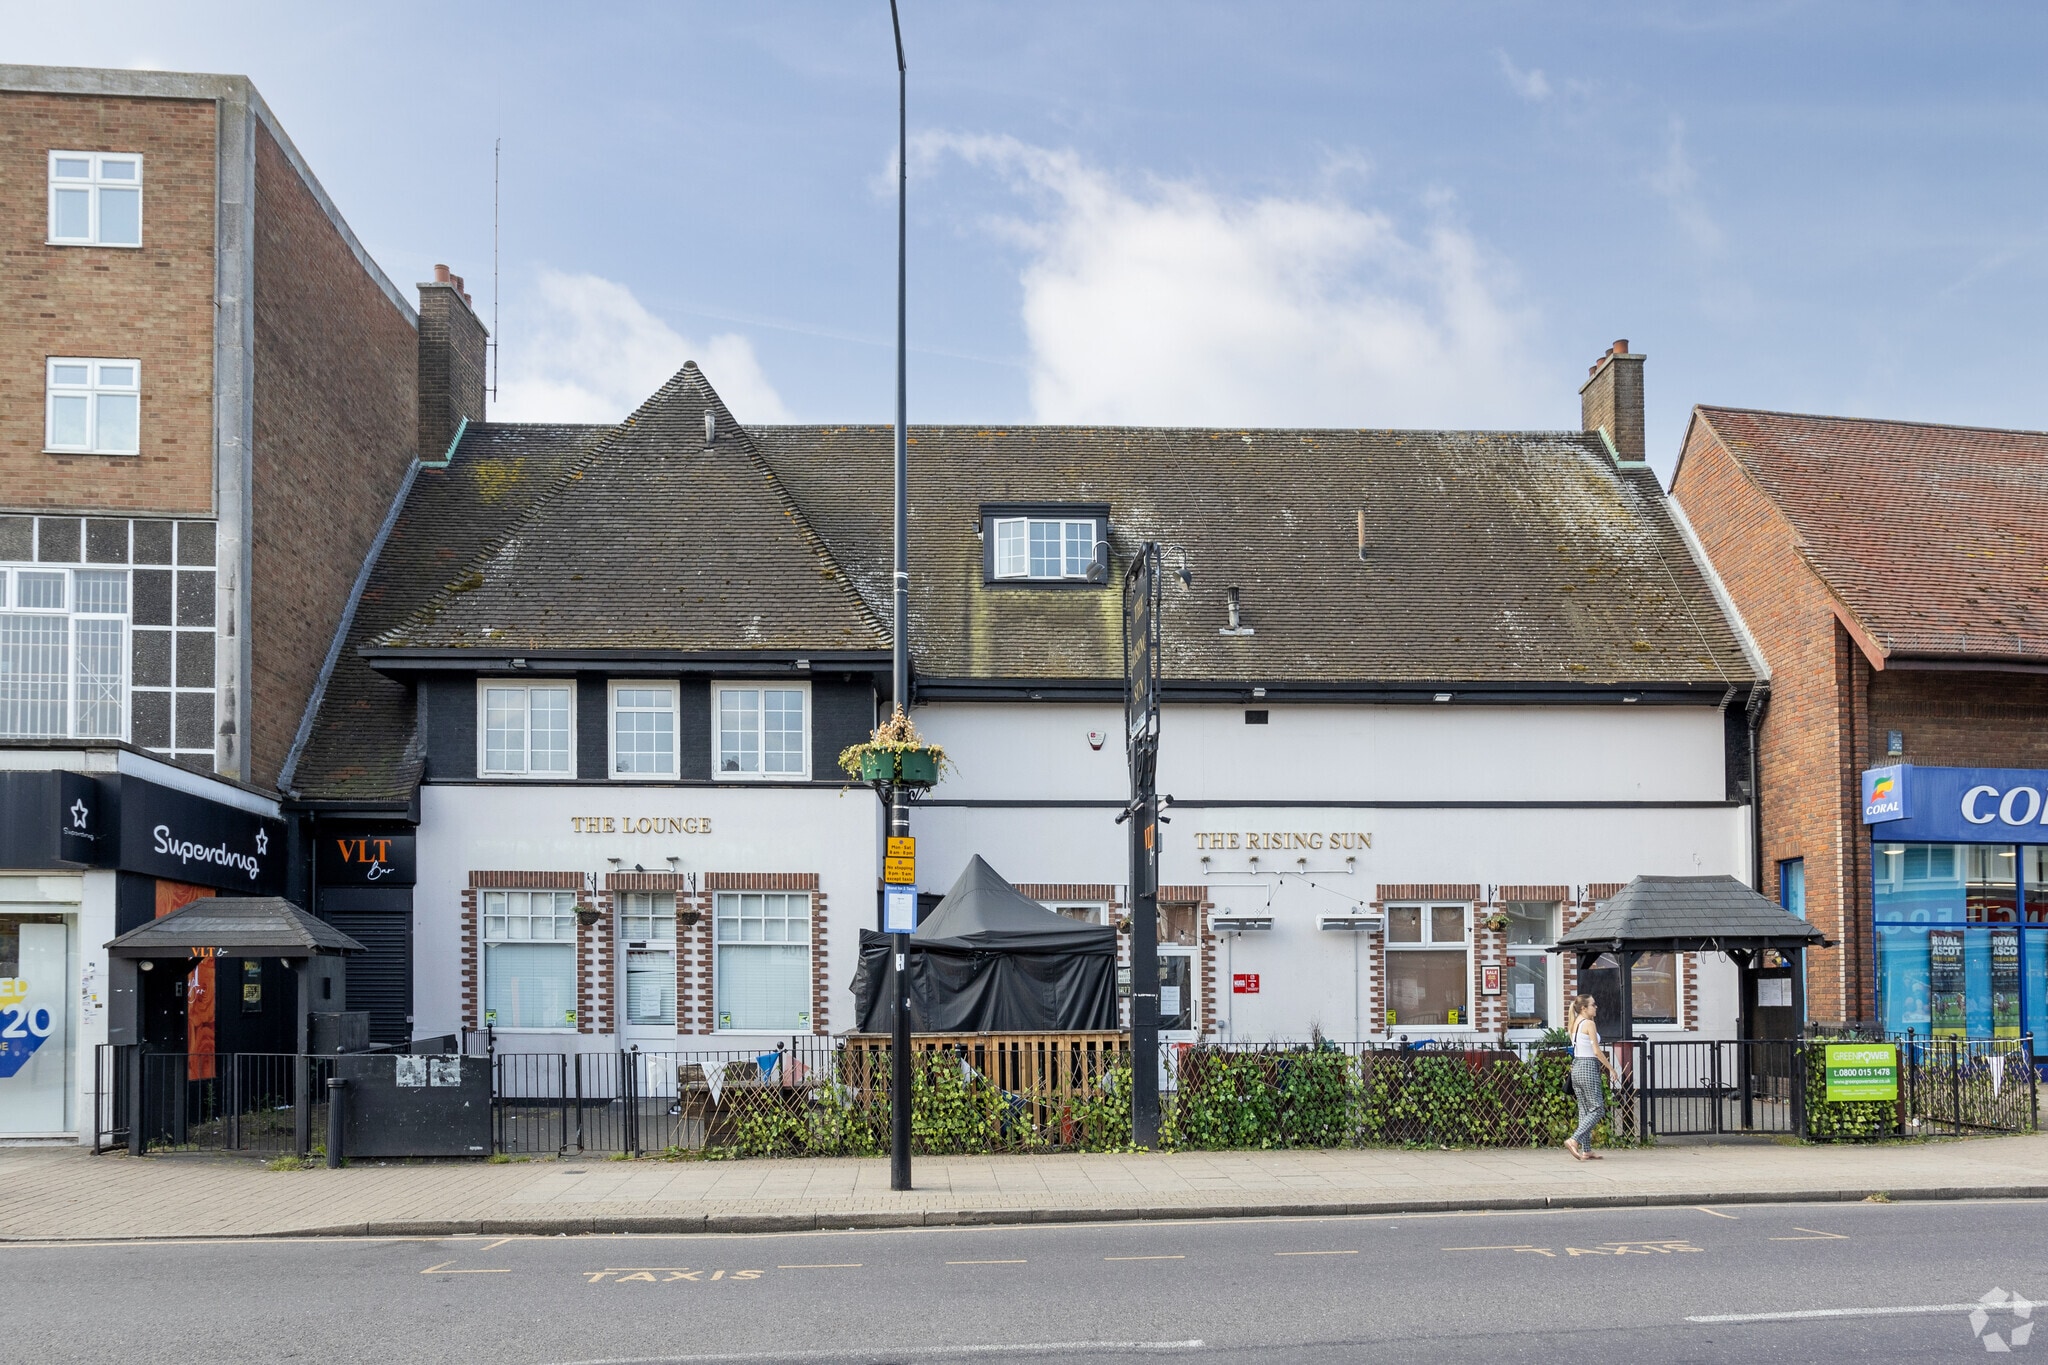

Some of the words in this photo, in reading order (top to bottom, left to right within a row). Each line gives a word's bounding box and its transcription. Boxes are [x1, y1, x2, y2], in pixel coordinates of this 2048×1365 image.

[1866, 801, 1899, 816] CORAL
[1961, 785, 2048, 826] CO
[571, 816, 616, 834] THE
[622, 816, 713, 835] LOUNGE
[1194, 832, 1240, 850] THE
[1245, 832, 1323, 850] RISING
[1329, 832, 1373, 850] SUN
[153, 824, 260, 880] Superdrug
[336, 839, 393, 863] VLT
[367, 859, 396, 881] Bar
[1931, 936, 1961, 946] ROYAL
[191, 947, 216, 957] VLT
[1932, 946, 1962, 956] ASCOT
[1993, 946, 2018, 956] ASCO
[2, 1002, 57, 1038] 20
[1833, 1051, 1890, 1064] GREENPOWER
[1833, 1068, 1857, 1077] t.0800
[1858, 1068, 1872, 1077] 015
[1873, 1067, 1890, 1076] 1478
[583, 1269, 765, 1284] TAXIS
